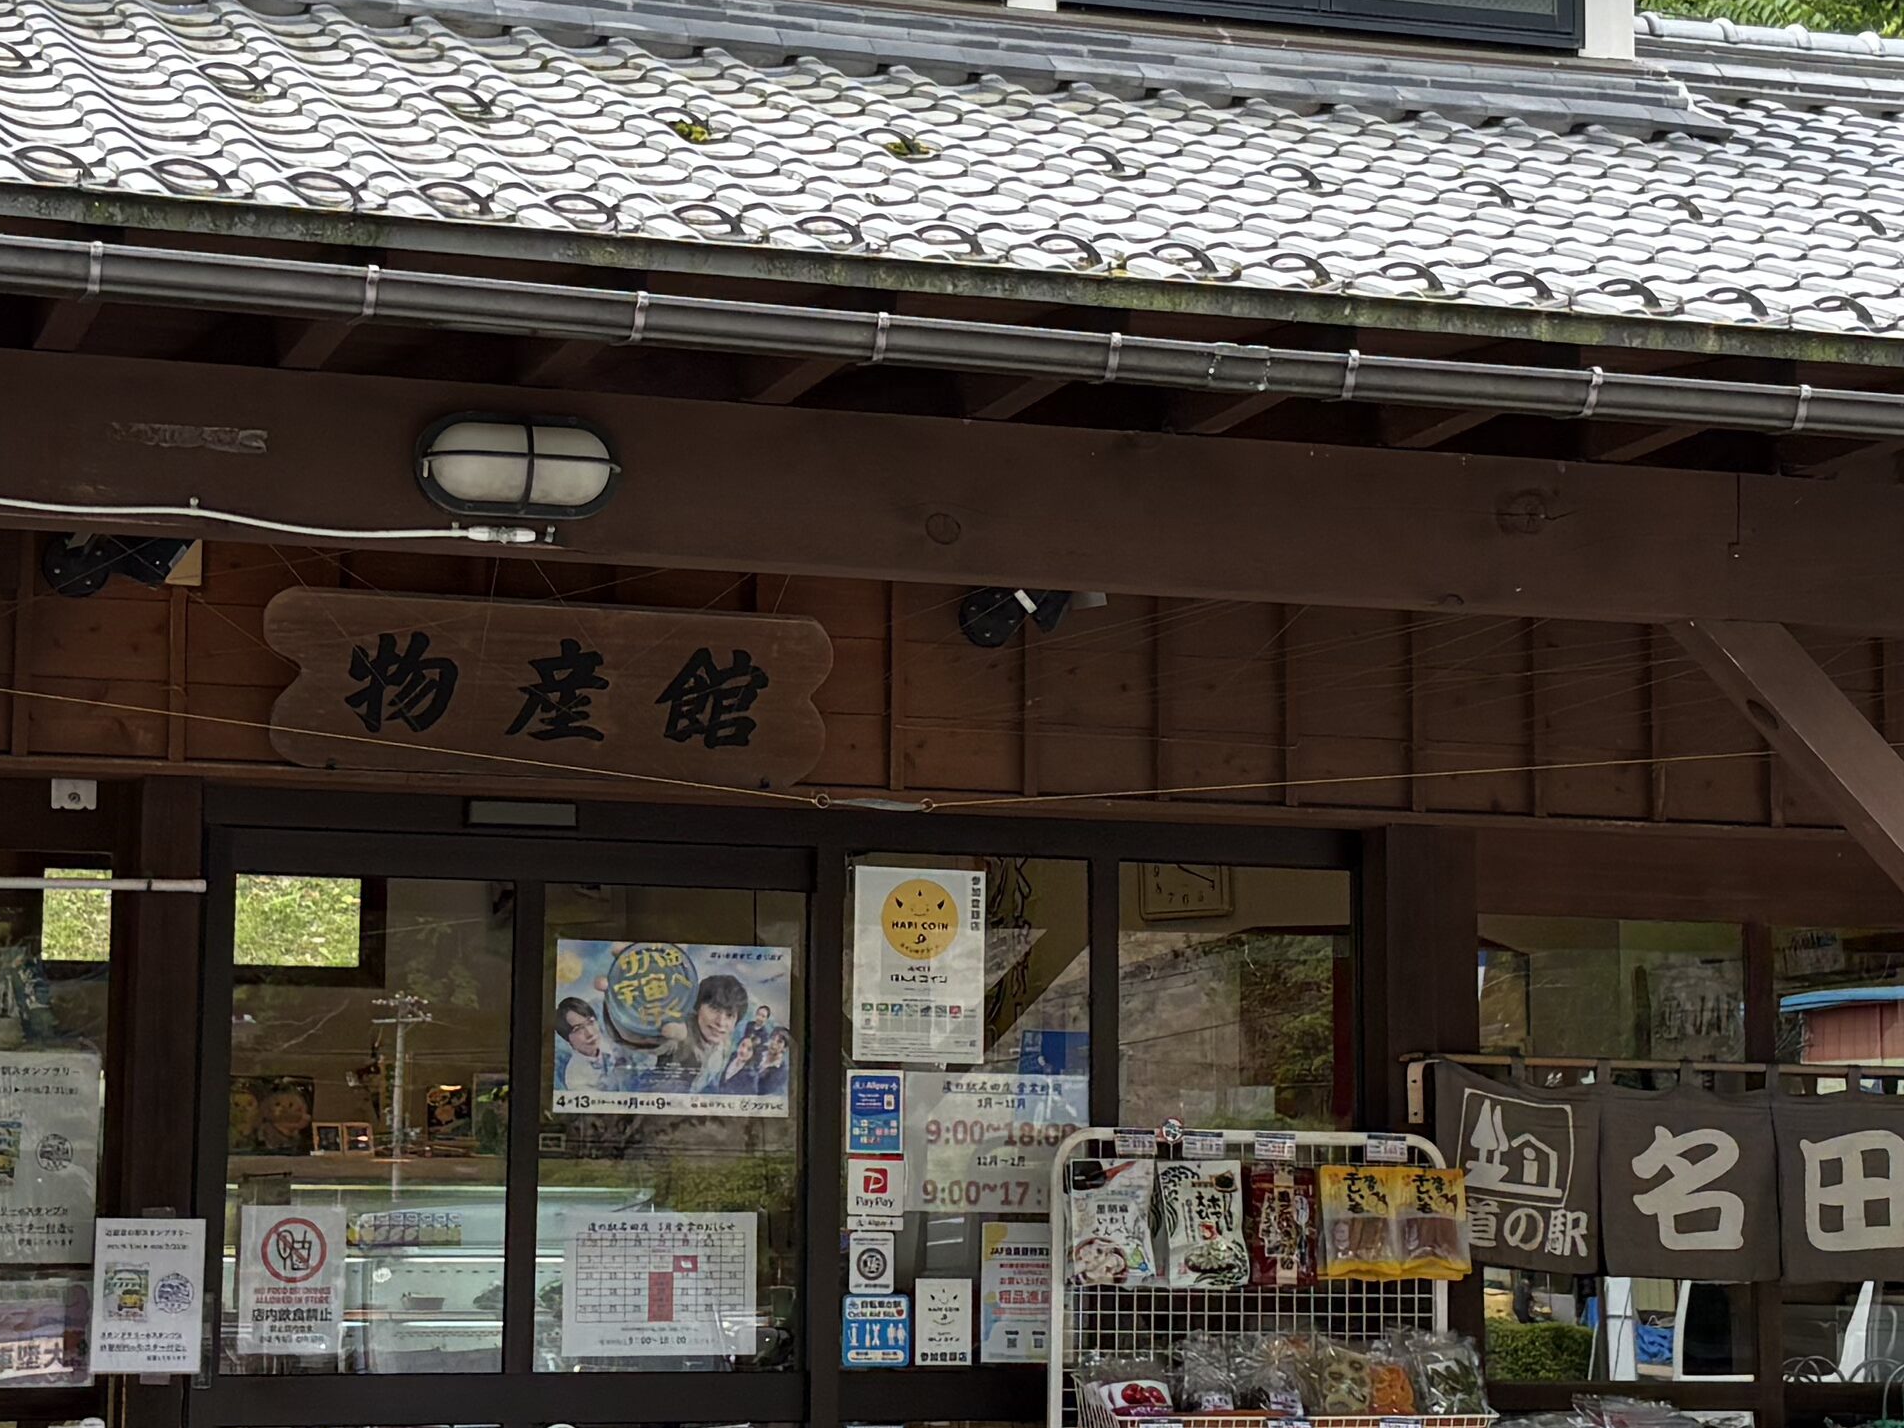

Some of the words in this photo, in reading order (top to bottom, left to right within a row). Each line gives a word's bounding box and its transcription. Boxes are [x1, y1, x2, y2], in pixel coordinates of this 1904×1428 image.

[344, 630, 769, 749] 物産館
[943, 1081, 1012, 1094] 道の駅名田庄
[856, 1195, 894, 1208] PayPay
[1466, 1197, 1588, 1259] 道の駅
[252, 1308, 332, 1322] 店内飲食禁止
